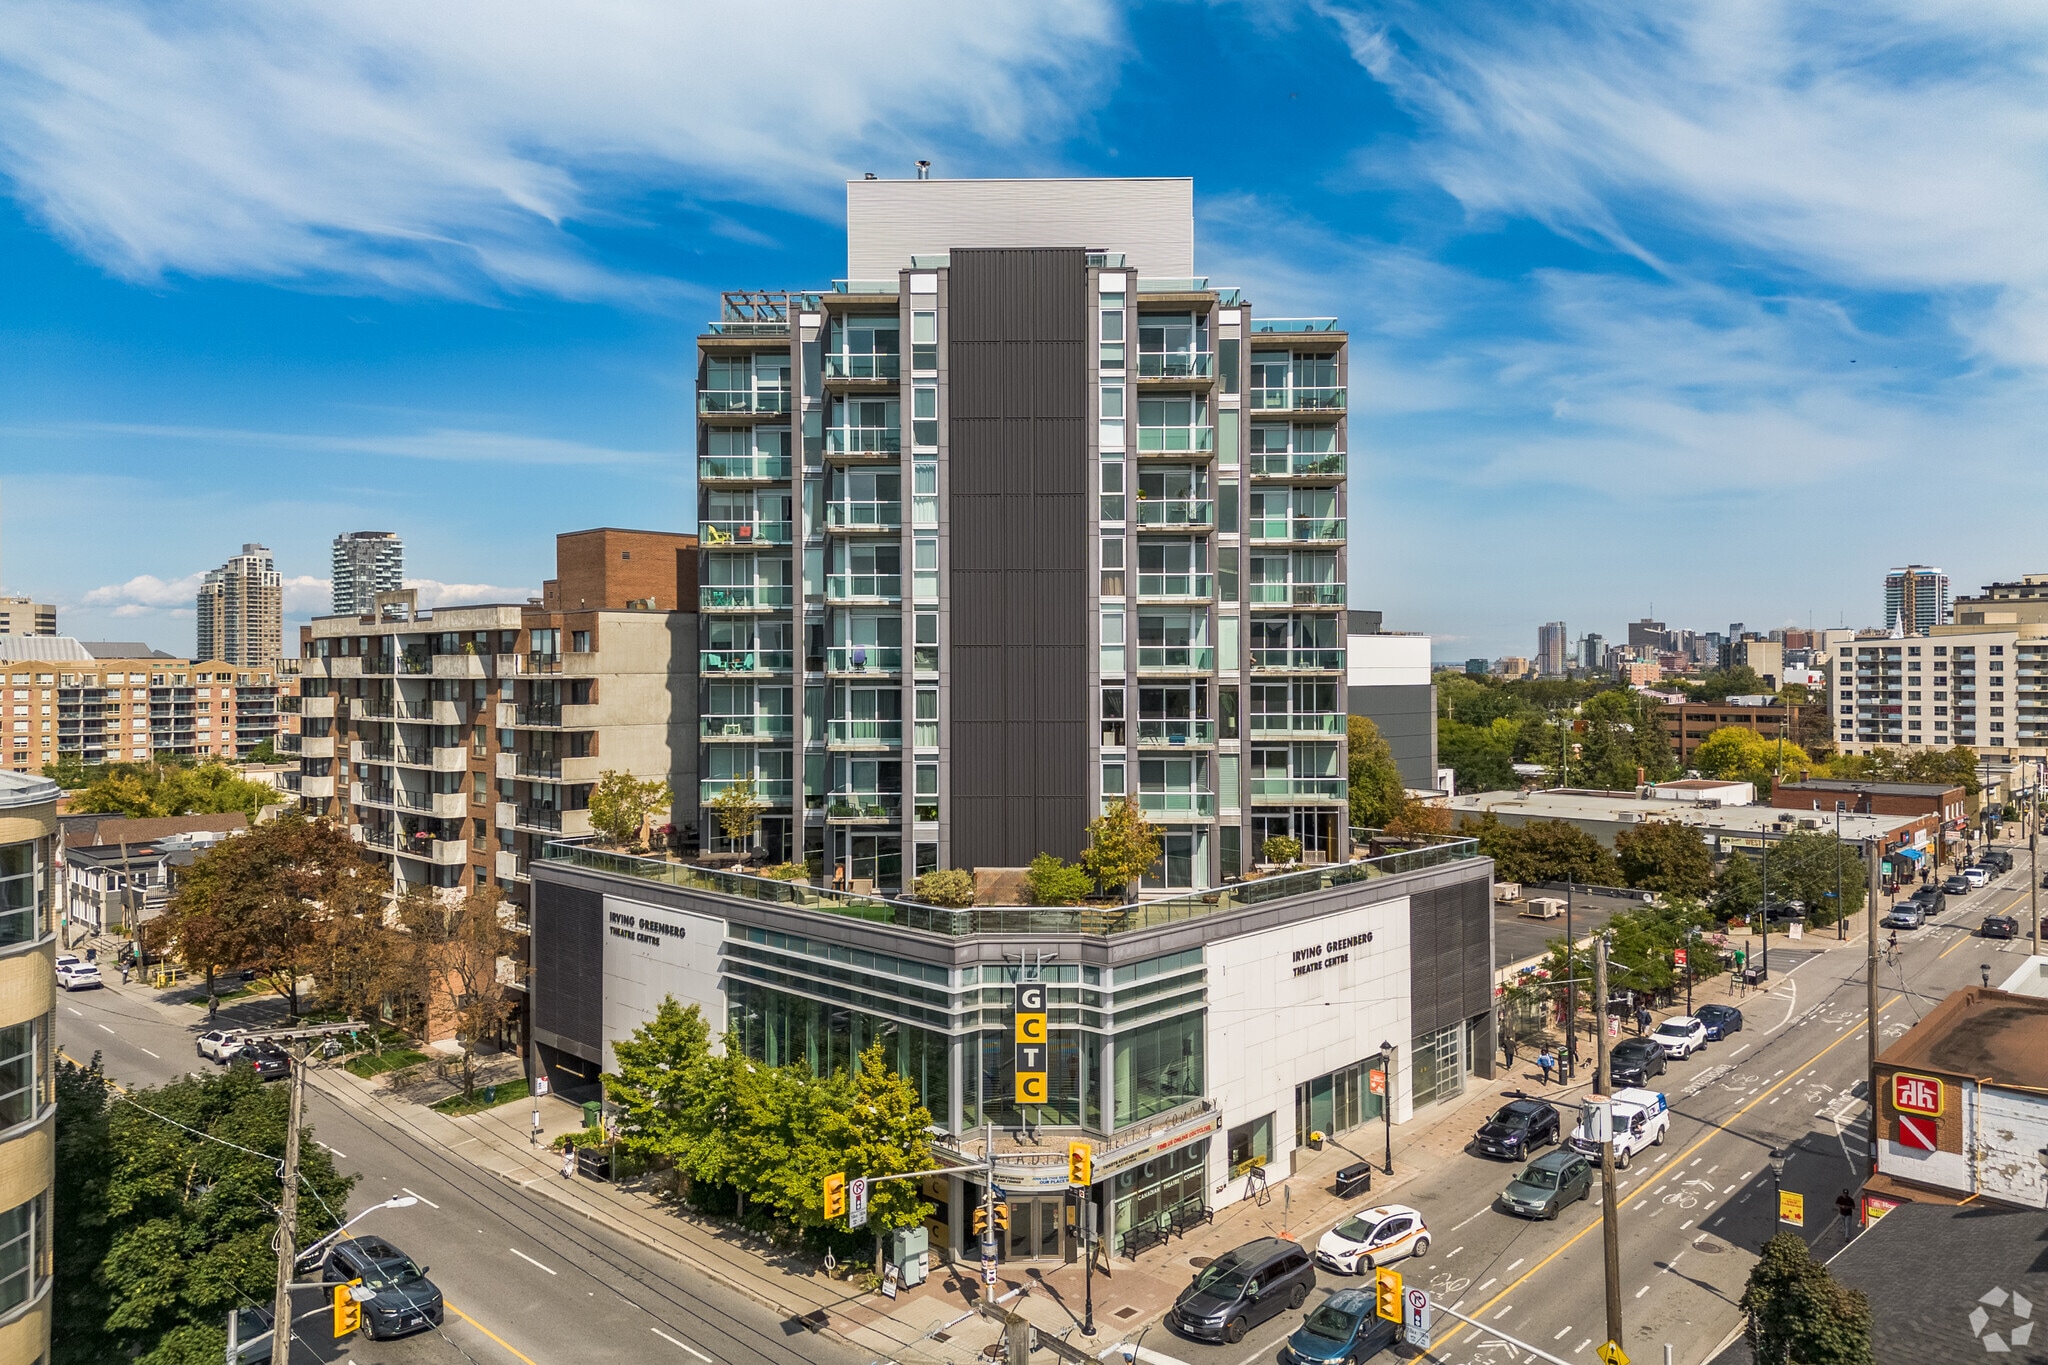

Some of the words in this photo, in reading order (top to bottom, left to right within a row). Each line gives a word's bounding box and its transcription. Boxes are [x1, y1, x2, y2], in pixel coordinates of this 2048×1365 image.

[609, 911, 635, 928] IRVING
[638, 918, 686, 940] GREENBERG
[609, 926, 636, 941] THEATRE
[636, 932, 660, 947] CENTRE
[1292, 945, 1322, 963] IRVING
[1326, 931, 1373, 953] GREENBERG
[1292, 961, 1323, 978] THEATRE
[1324, 953, 1349, 969] CENTRE
[1173, 1133, 1189, 1144] ONLINE
[1118, 1152, 1138, 1163] AVAILABLE
[1137, 1186, 1161, 1201] CANADIAN
[1183, 1167, 1205, 1181] COMPANY
